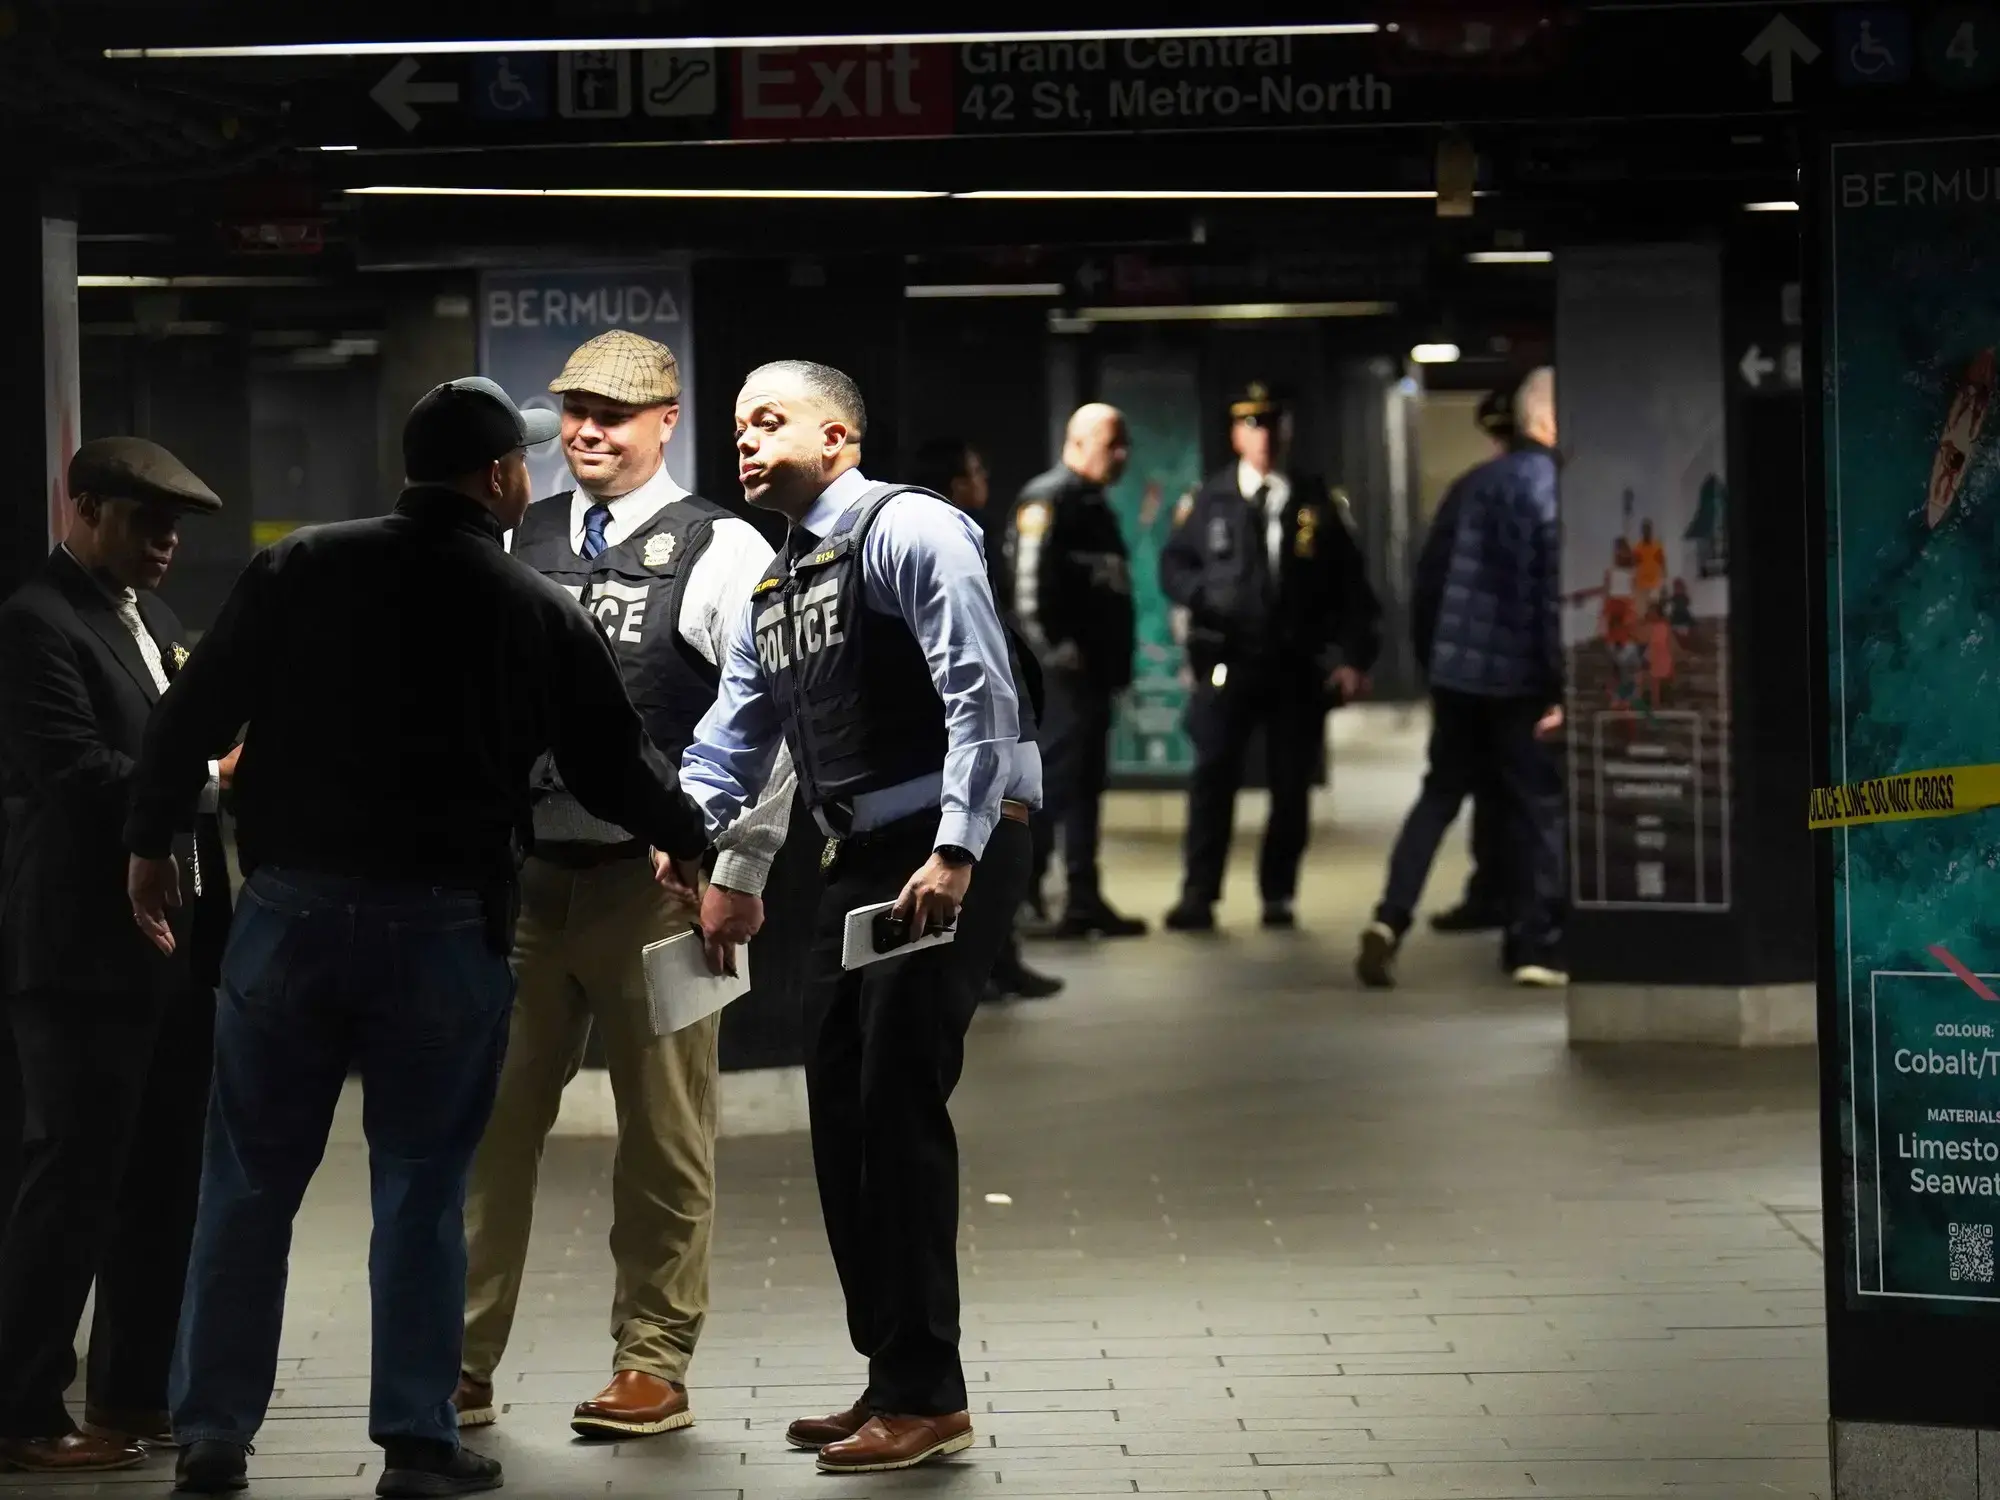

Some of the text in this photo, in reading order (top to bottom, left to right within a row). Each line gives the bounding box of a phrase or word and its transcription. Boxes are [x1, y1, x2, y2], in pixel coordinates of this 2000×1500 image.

[960, 35, 1293, 74] Grand Central
[1945, 21, 1979, 68] 4
[741, 45, 922, 120] Exit
[961, 72, 1393, 127] 42 St, Metro-North
[1842, 166, 2000, 208] BERMU
[488, 286, 680, 327] BERMUDA
[756, 597, 845, 677] POLICE
[1808, 773, 1954, 821] OLICE LINE DO NOT CROSS
[1935, 1023, 1994, 1038] COLOUR:
[1894, 1047, 2000, 1079] Cobalt/T
[1898, 1131, 1999, 1162] Limesto
[1910, 1168, 2000, 1196] Seawat
